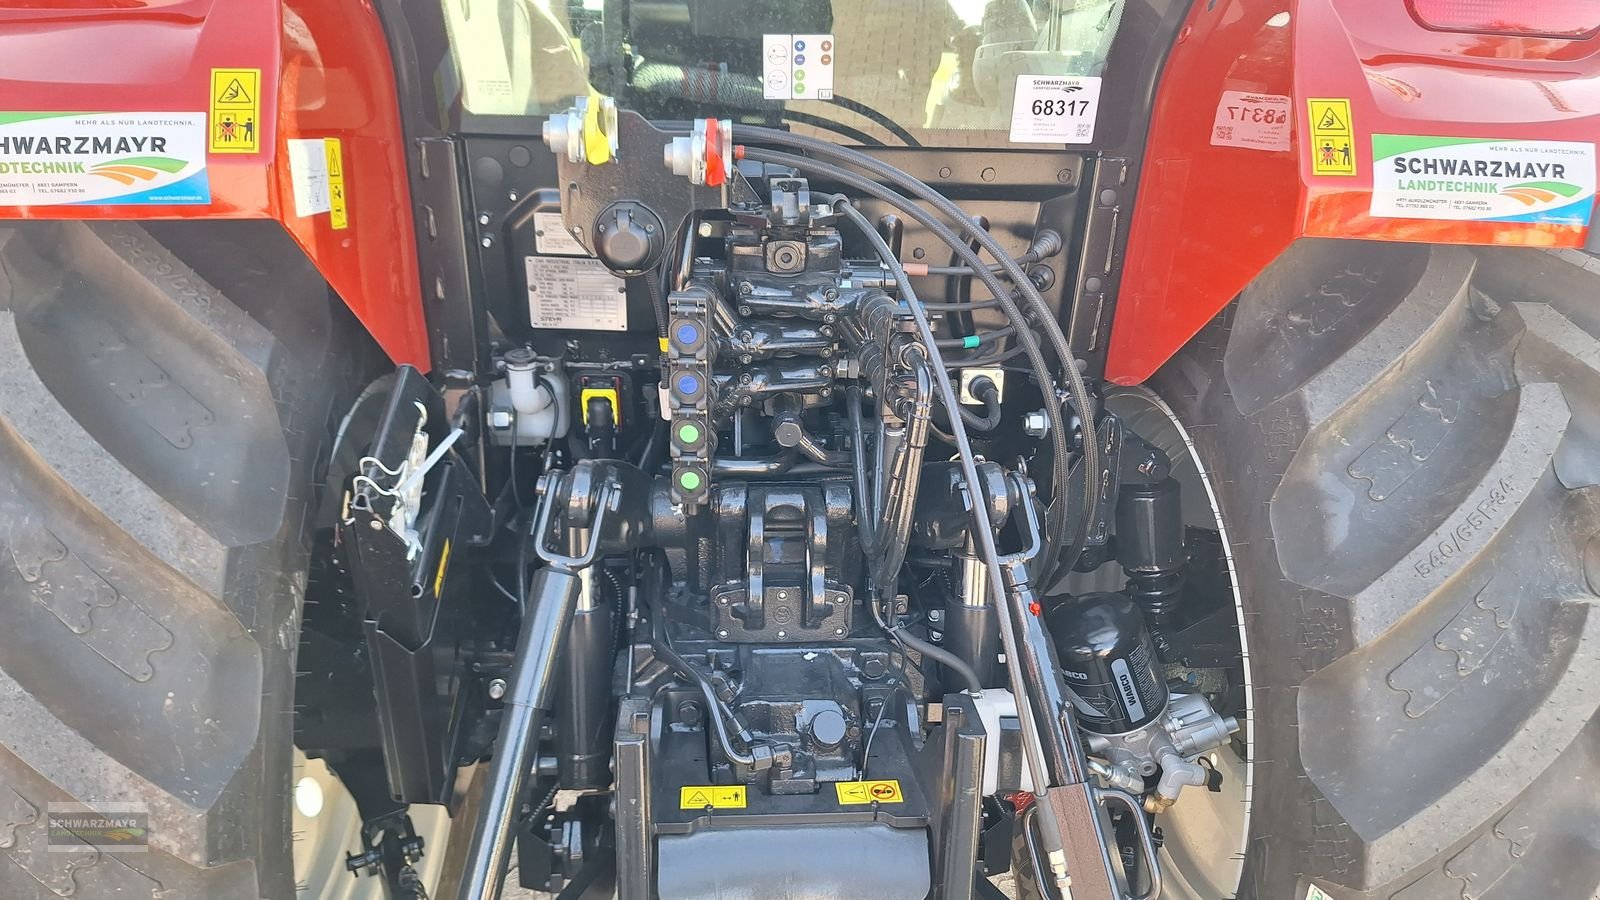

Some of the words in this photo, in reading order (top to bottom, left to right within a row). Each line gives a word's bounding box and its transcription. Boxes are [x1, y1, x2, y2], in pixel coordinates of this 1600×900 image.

[1032, 99, 1090, 117] 68317
[1394, 157, 1566, 180] SCHWARZMAYR
[1397, 179, 1499, 194] LANDTECHNIK
[1119, 673, 1137, 707] WABCO
